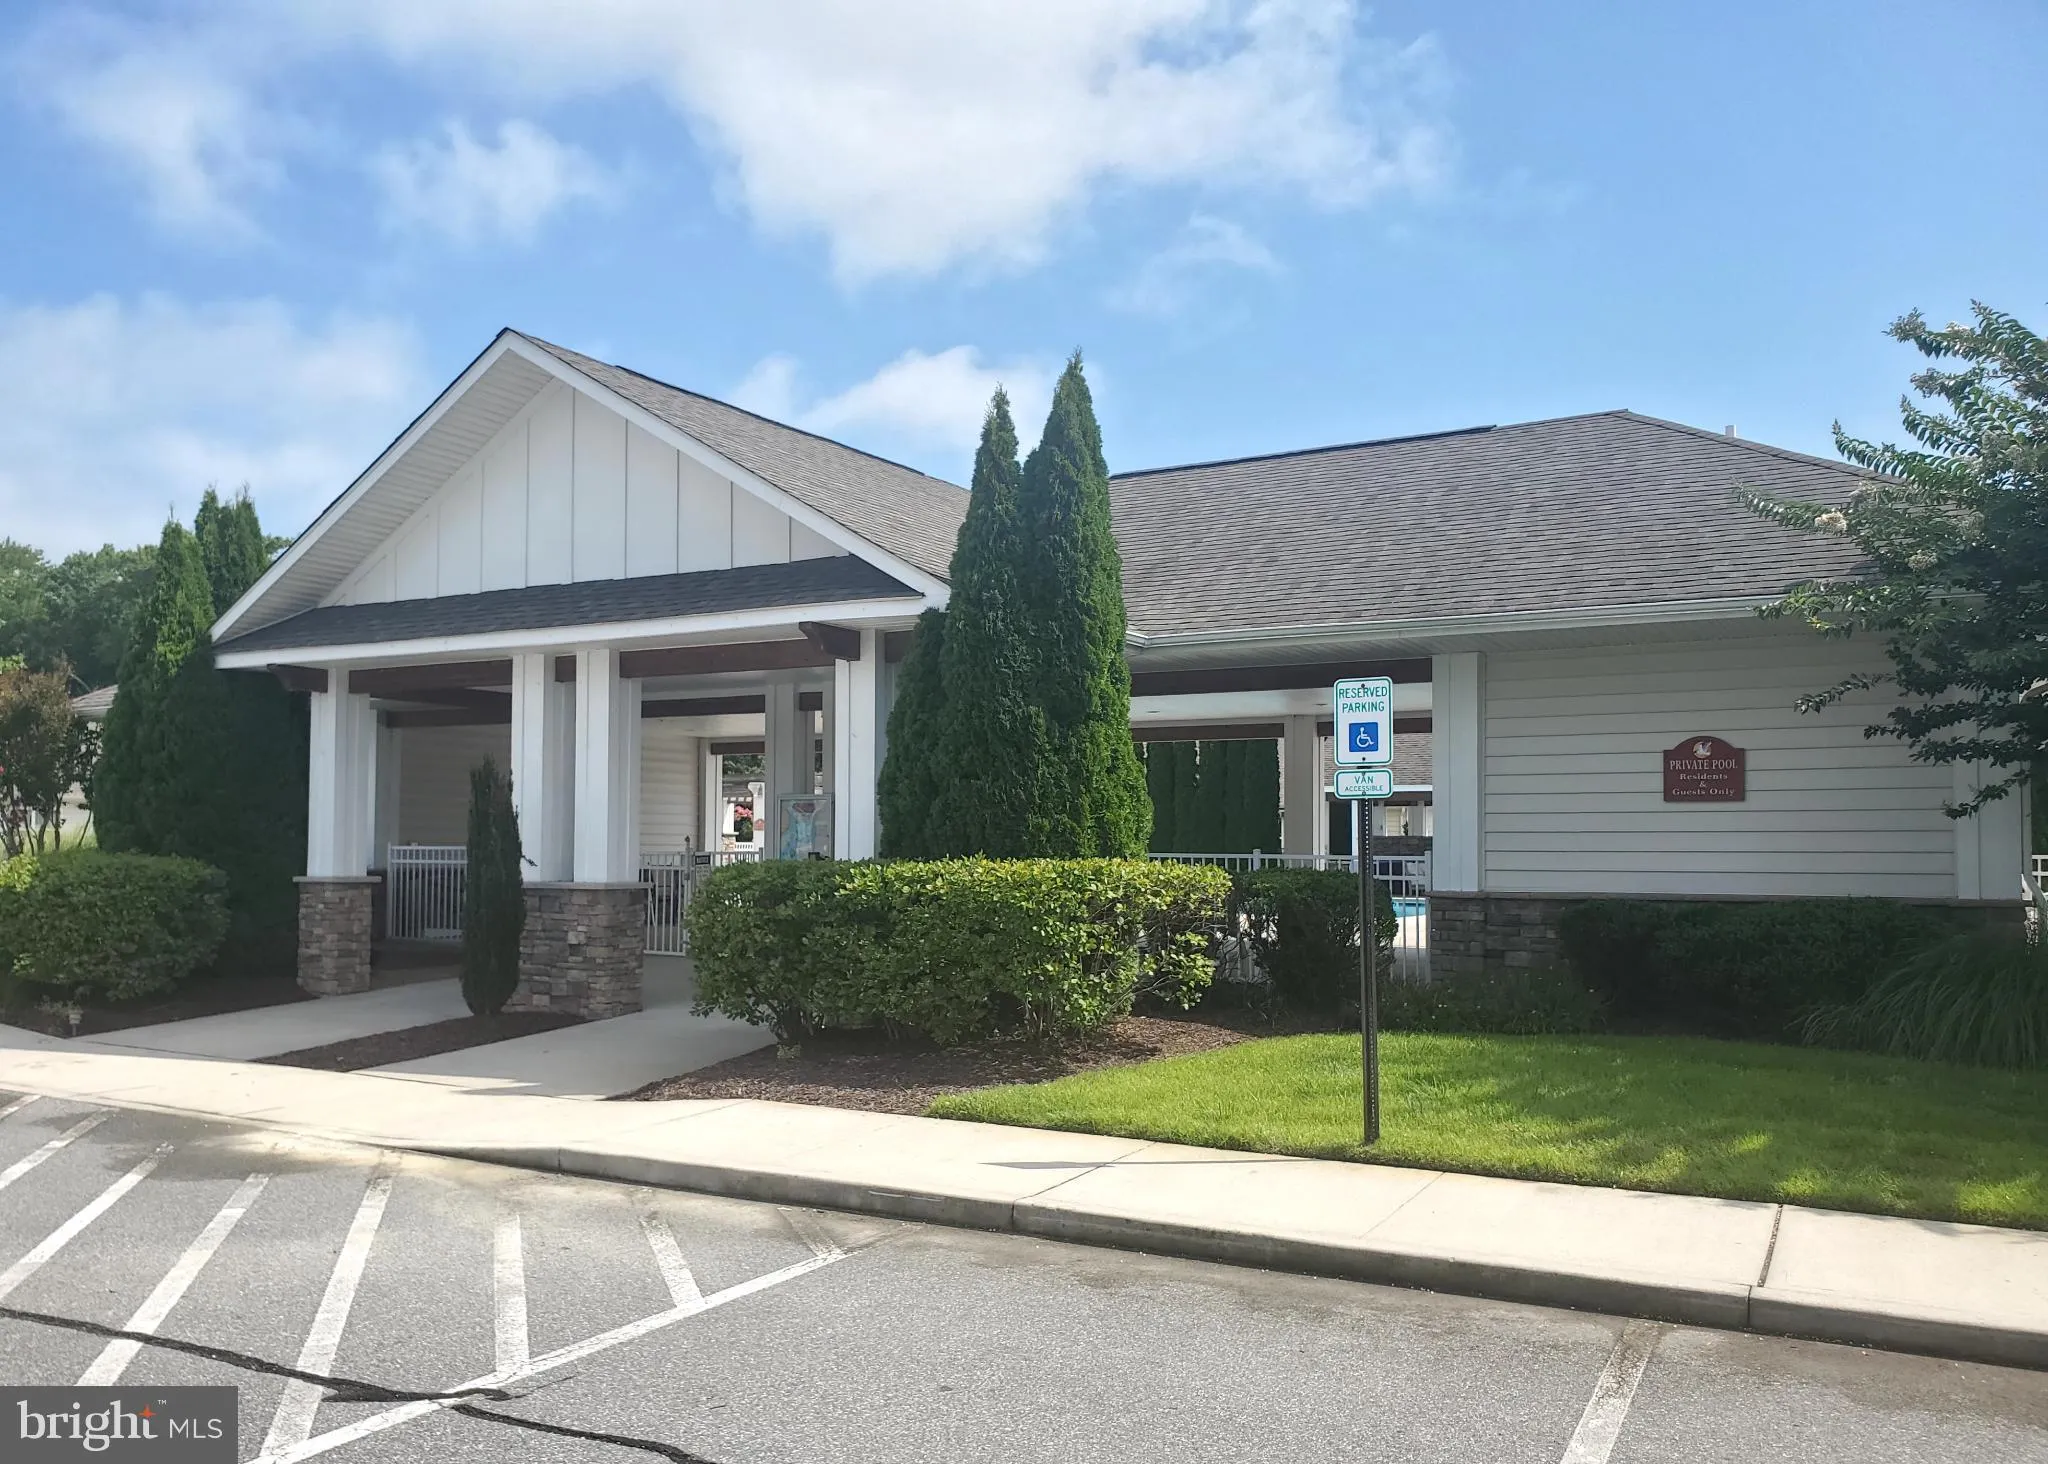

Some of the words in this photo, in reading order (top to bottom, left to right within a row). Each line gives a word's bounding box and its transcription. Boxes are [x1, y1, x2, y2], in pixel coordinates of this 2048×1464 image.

[1339, 686, 1388, 699] RESERVED
[1342, 701, 1385, 713] PARKING
[1670, 759, 1709, 770] PRIVATE
[1712, 759, 1738, 770] POOL
[1354, 776, 1374, 784] VAN
[1709, 788, 1735, 796] Only
